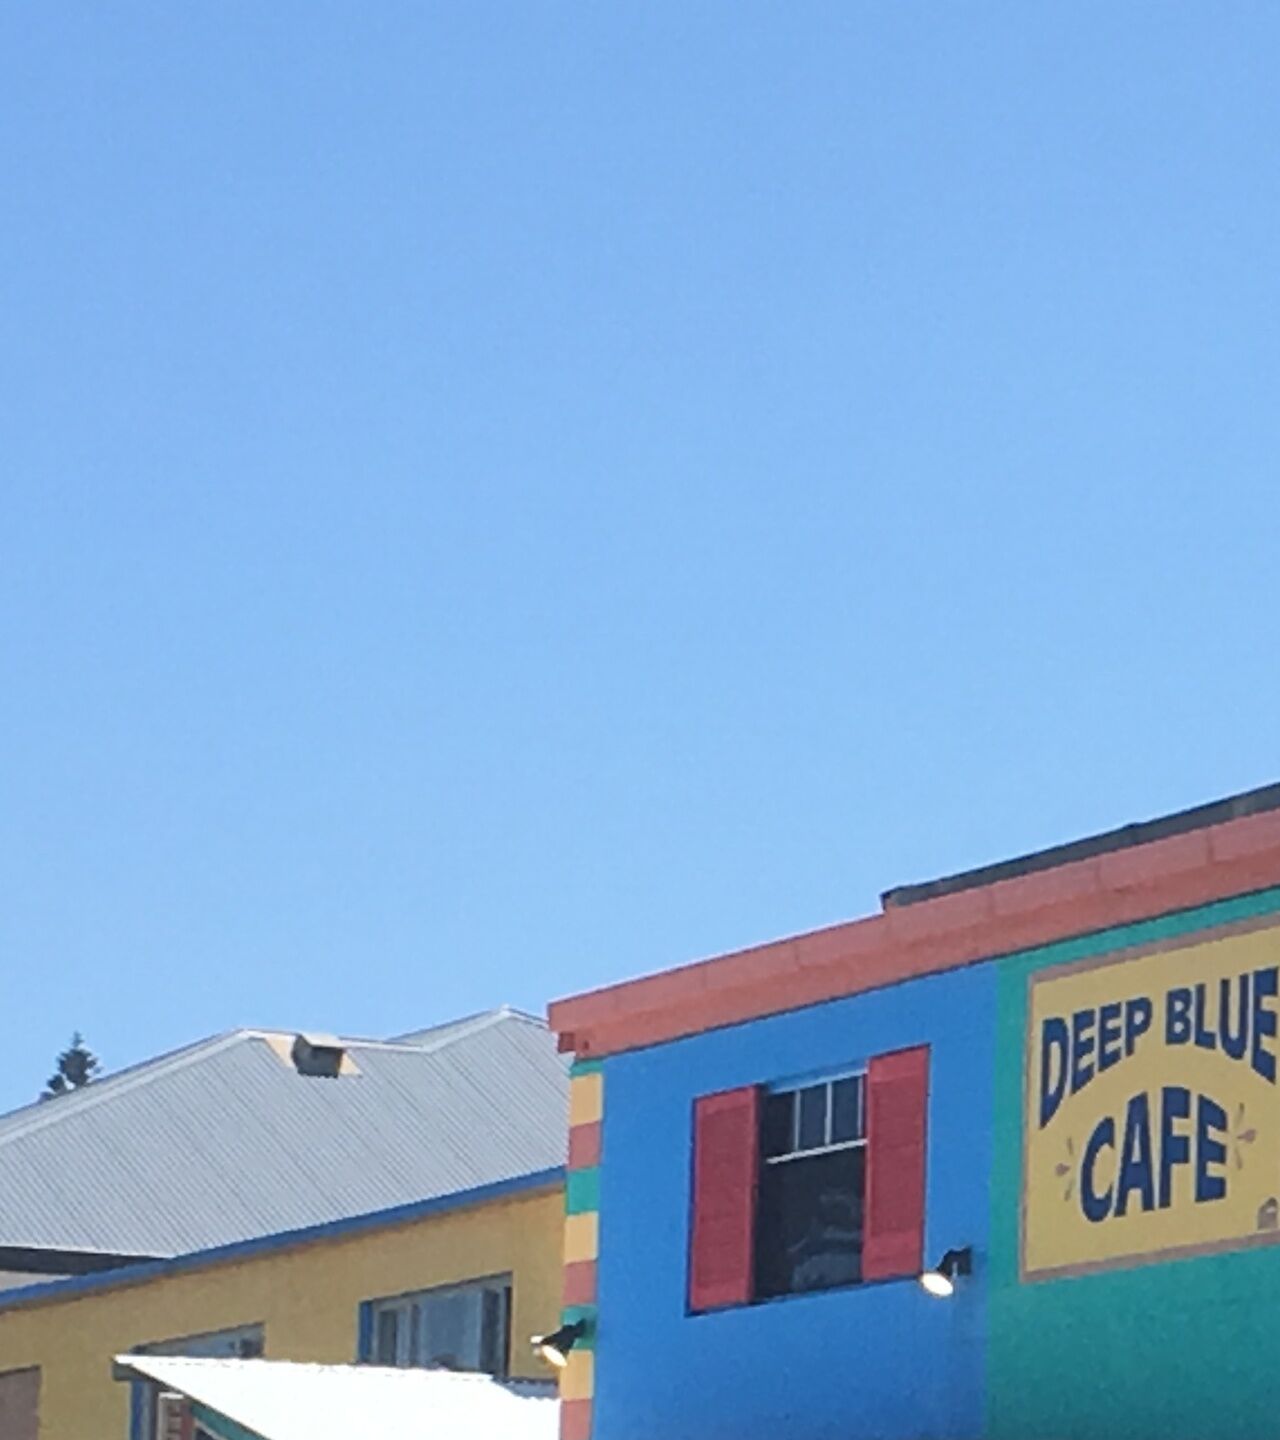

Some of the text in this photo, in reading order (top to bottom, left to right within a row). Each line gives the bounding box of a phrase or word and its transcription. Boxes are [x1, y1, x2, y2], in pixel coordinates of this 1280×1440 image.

[1038, 965, 1280, 1130] DEEP BLUE
[1079, 1086, 1228, 1223] CAFE
